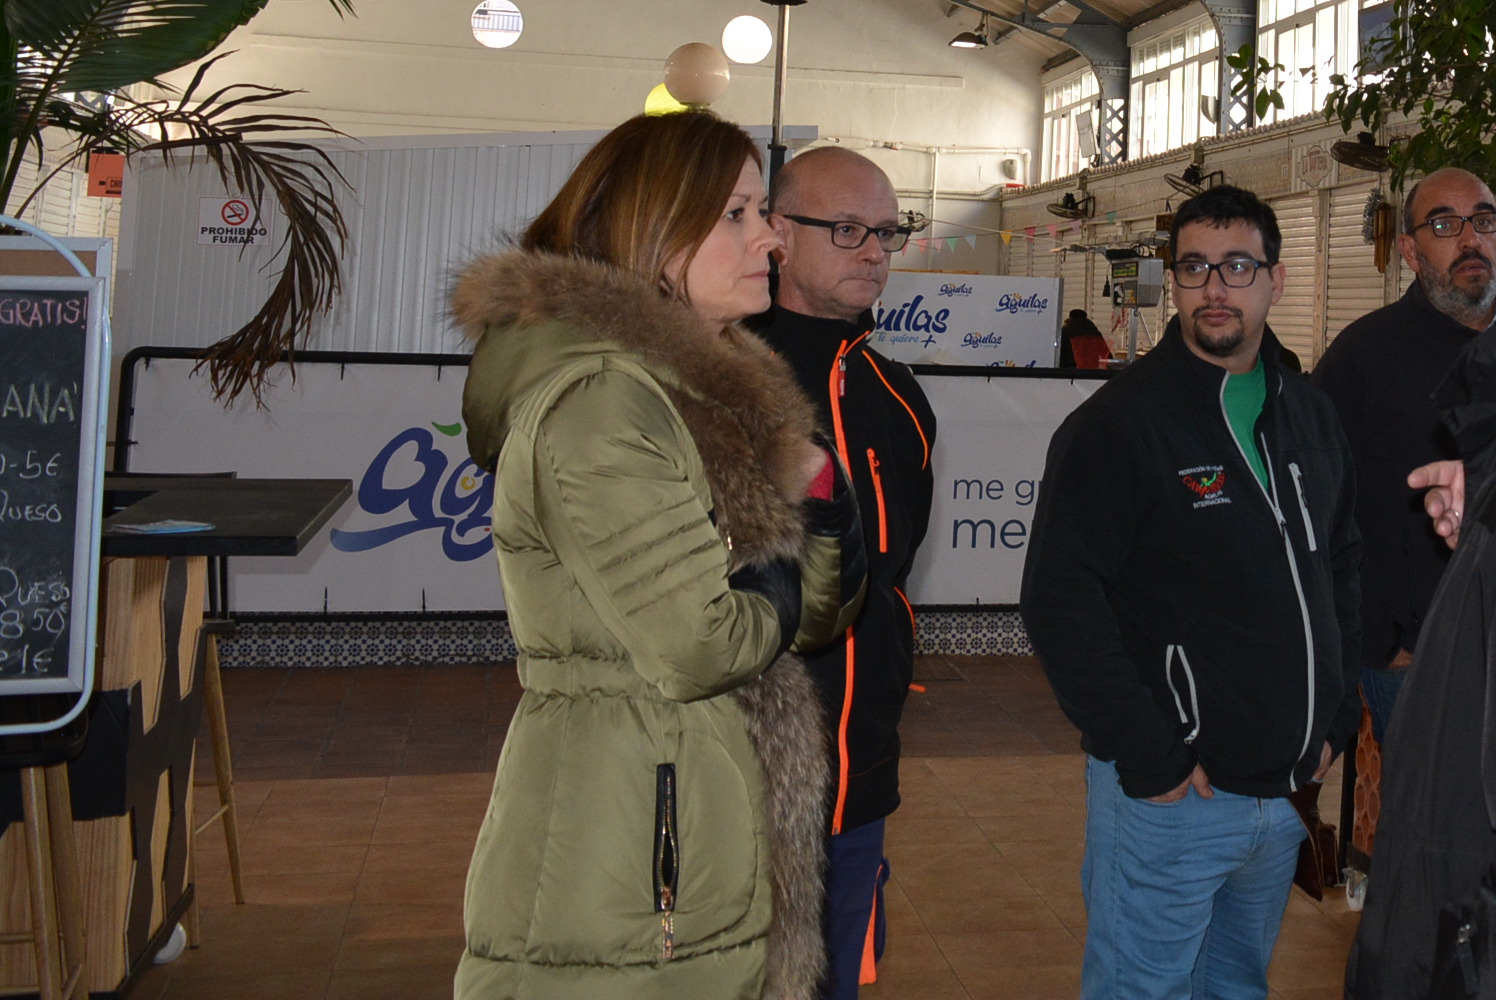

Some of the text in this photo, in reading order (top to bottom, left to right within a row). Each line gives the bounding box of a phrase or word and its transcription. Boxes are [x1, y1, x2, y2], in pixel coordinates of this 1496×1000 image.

[200, 226, 267, 237] PROHIBIDO
[212, 235, 255, 245] FUMAR
[876, 294, 950, 334] uilas
[889, 333, 920, 346] quiere
[952, 479, 1041, 506] me g
